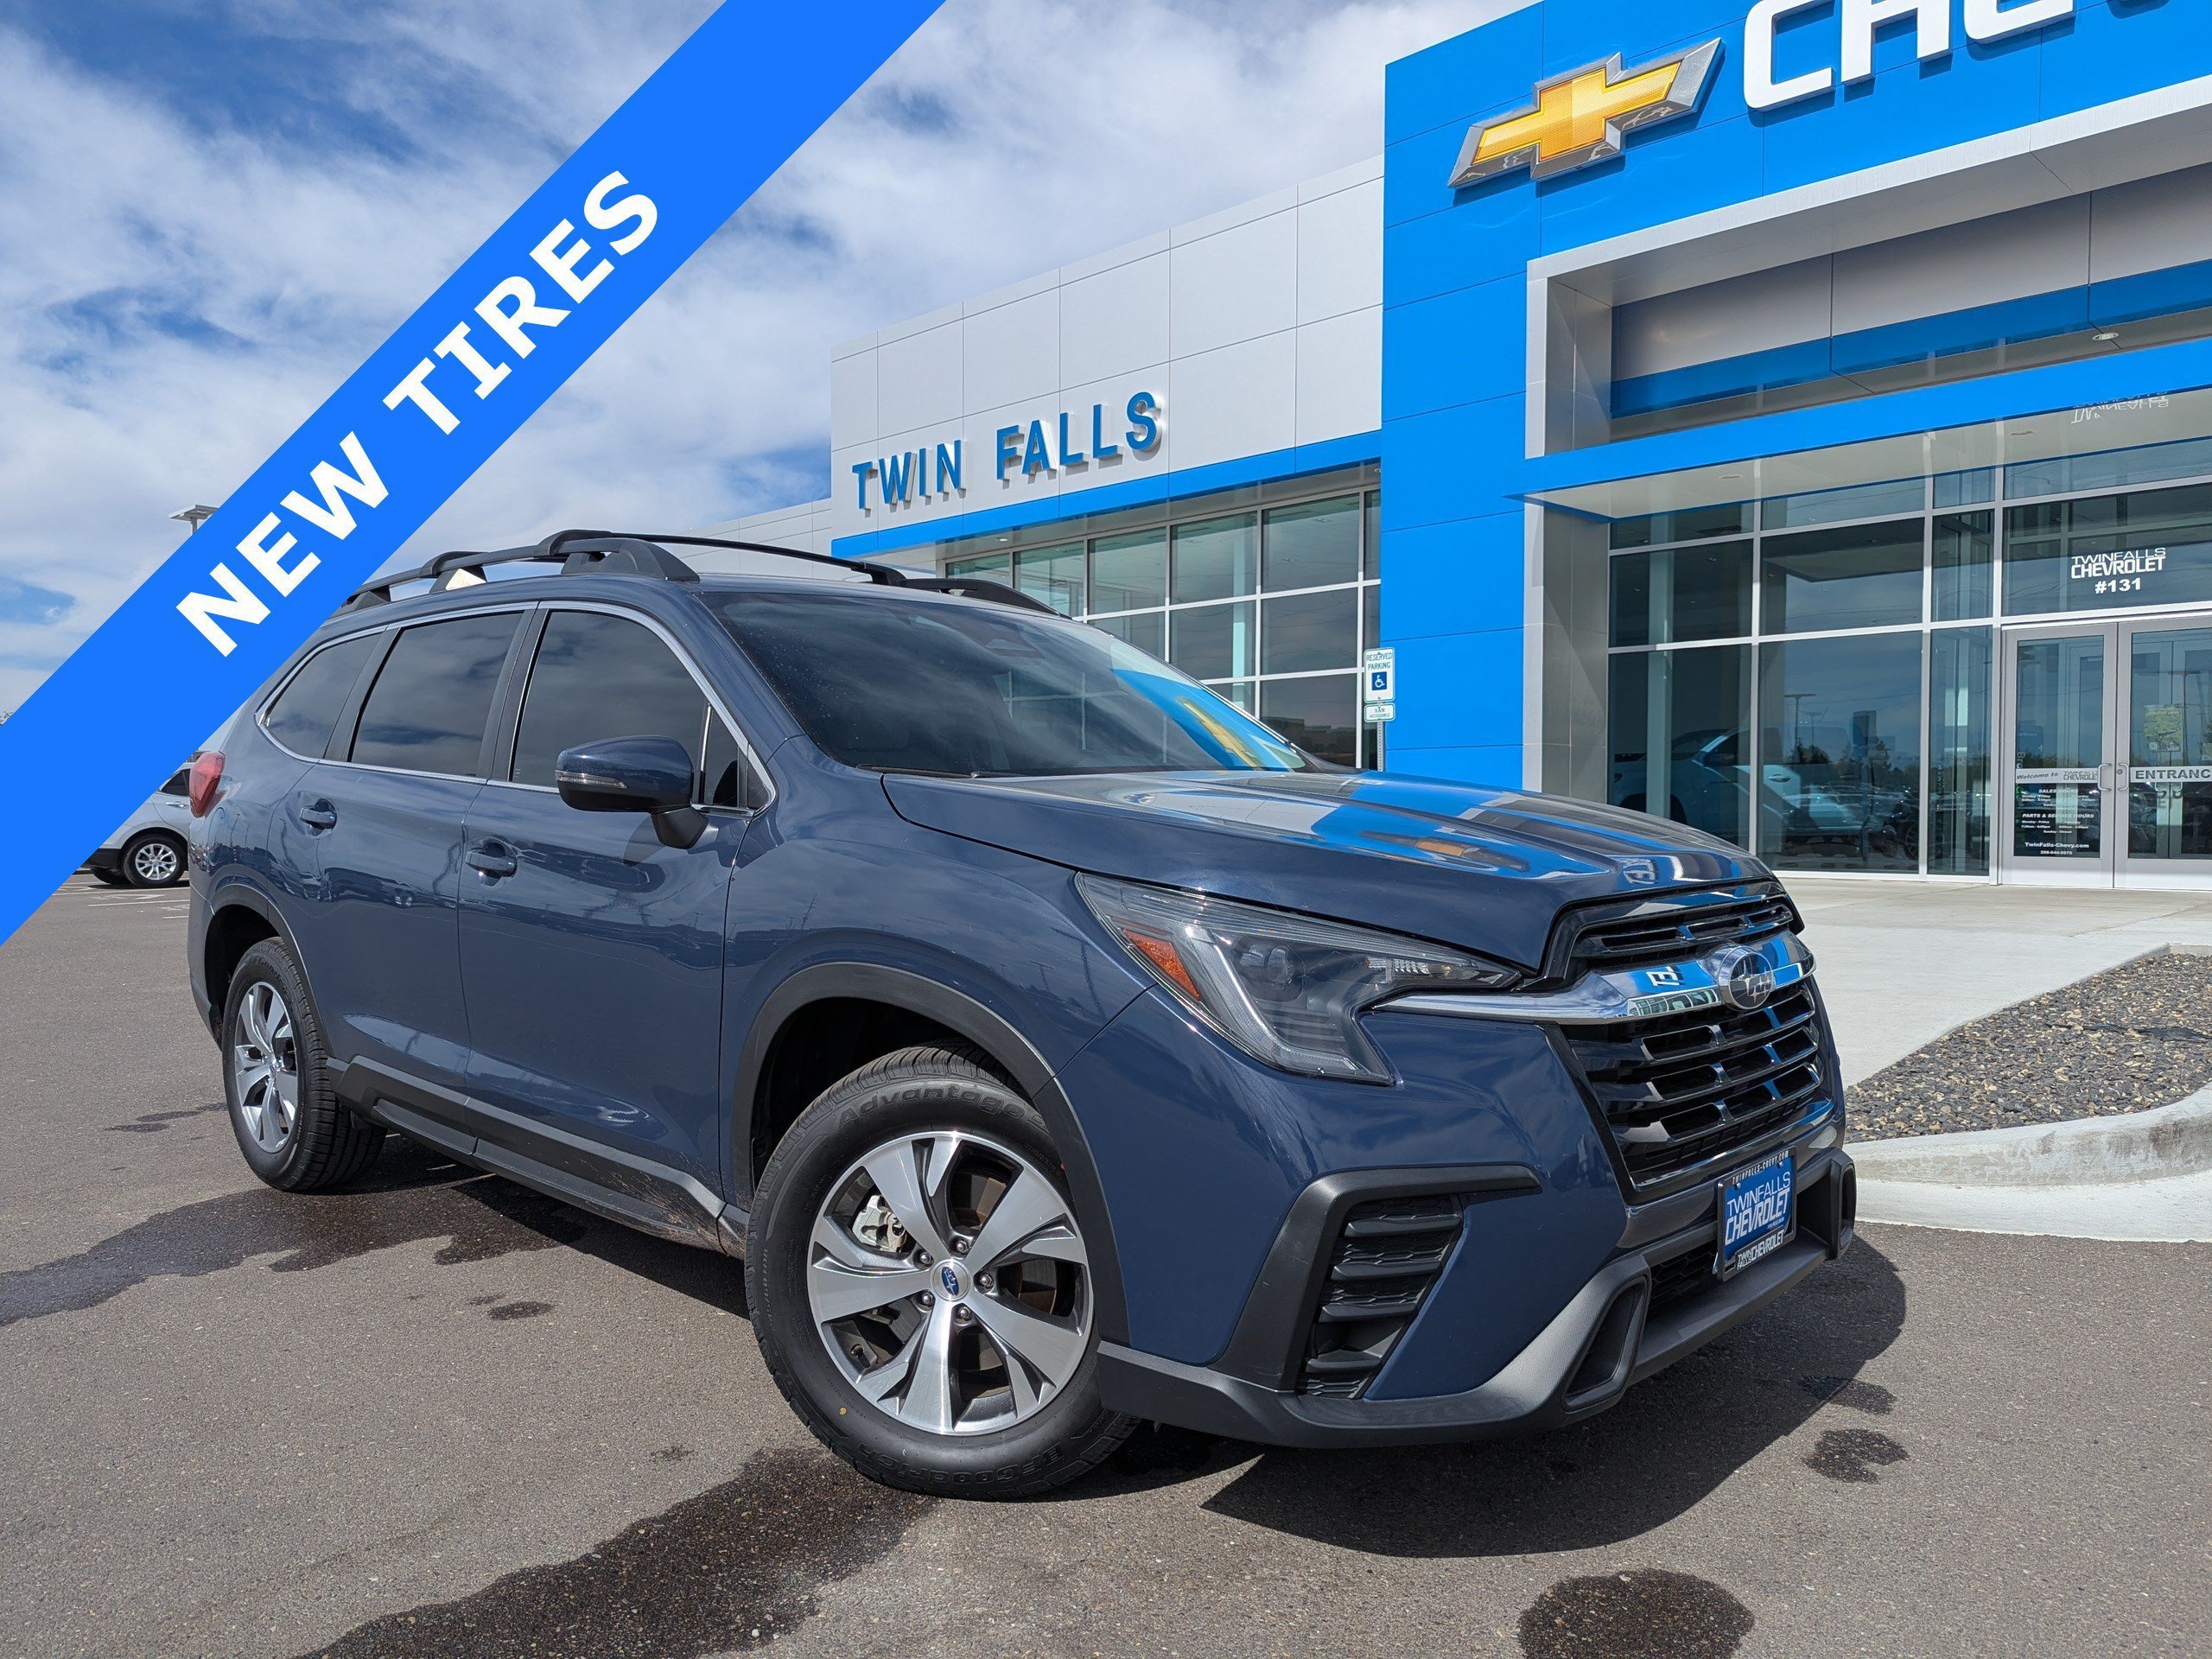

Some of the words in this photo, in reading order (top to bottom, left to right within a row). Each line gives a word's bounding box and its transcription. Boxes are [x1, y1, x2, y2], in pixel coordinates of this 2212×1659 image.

[852, 439, 963, 511] TWIN
[996, 391, 1160, 480] FALLS
[2071, 547, 2166, 565] TWINFALLS
[2071, 556, 2166, 579] CHEVROLET
[2094, 577, 2141, 594] #131
[1367, 652, 1393, 661] RESERVED
[1368, 662, 1391, 671] PARKING
[2135, 769, 2211, 779] ENTRANC
[838, 1084, 1026, 1130] Advantage
[1727, 1171, 1790, 1217] TWINFALLS
[1725, 1186, 1790, 1245] CHEVROLET
[1751, 1230, 1785, 1262] CHEVROLET
